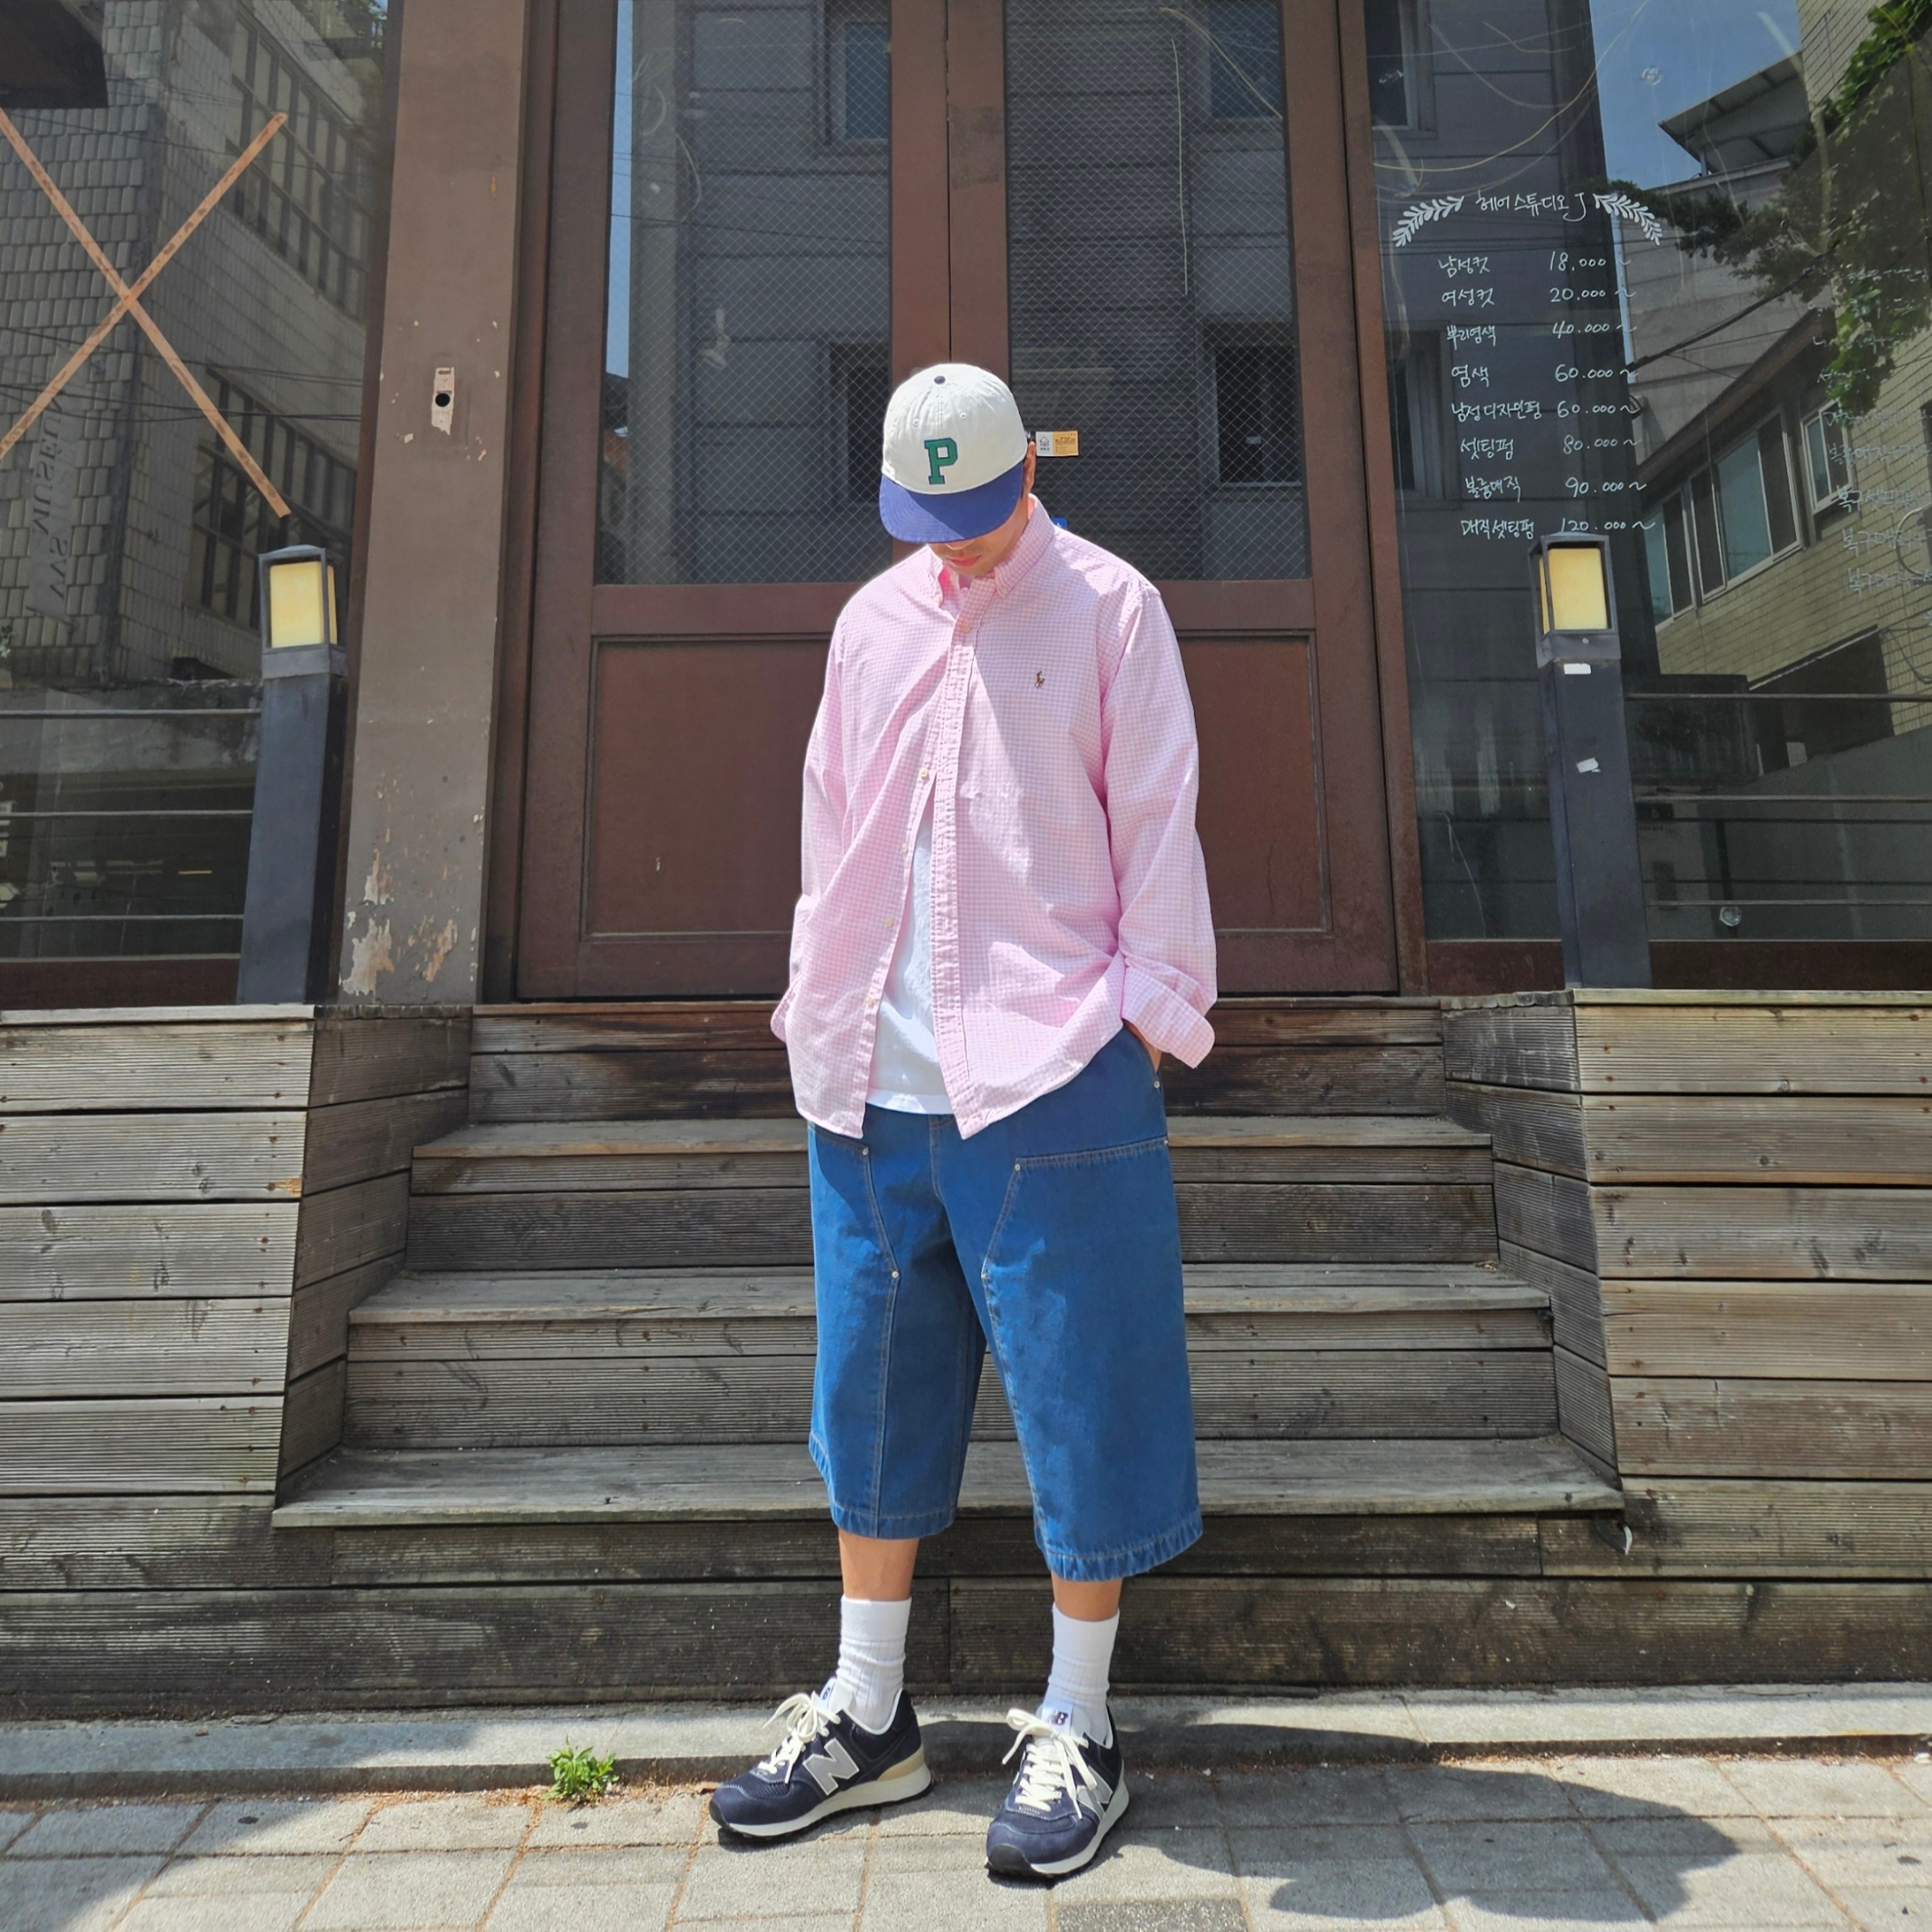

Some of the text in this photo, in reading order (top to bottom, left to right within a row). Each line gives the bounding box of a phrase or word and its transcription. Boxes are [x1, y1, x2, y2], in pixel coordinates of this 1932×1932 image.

[1437, 255, 1490, 278] 남성컷
[1442, 287, 1495, 308] 여성컷
[1446, 324, 1497, 351] 뿌리염색
[1451, 364, 1490, 388] 염색
[924, 437, 958, 485] P
[1460, 436, 1514, 461] 셋팅펌
[1464, 475, 1521, 503] 볼륨매직
[1461, 519, 1534, 540] 매직셋팅펌
[802, 1738, 859, 1797] N
